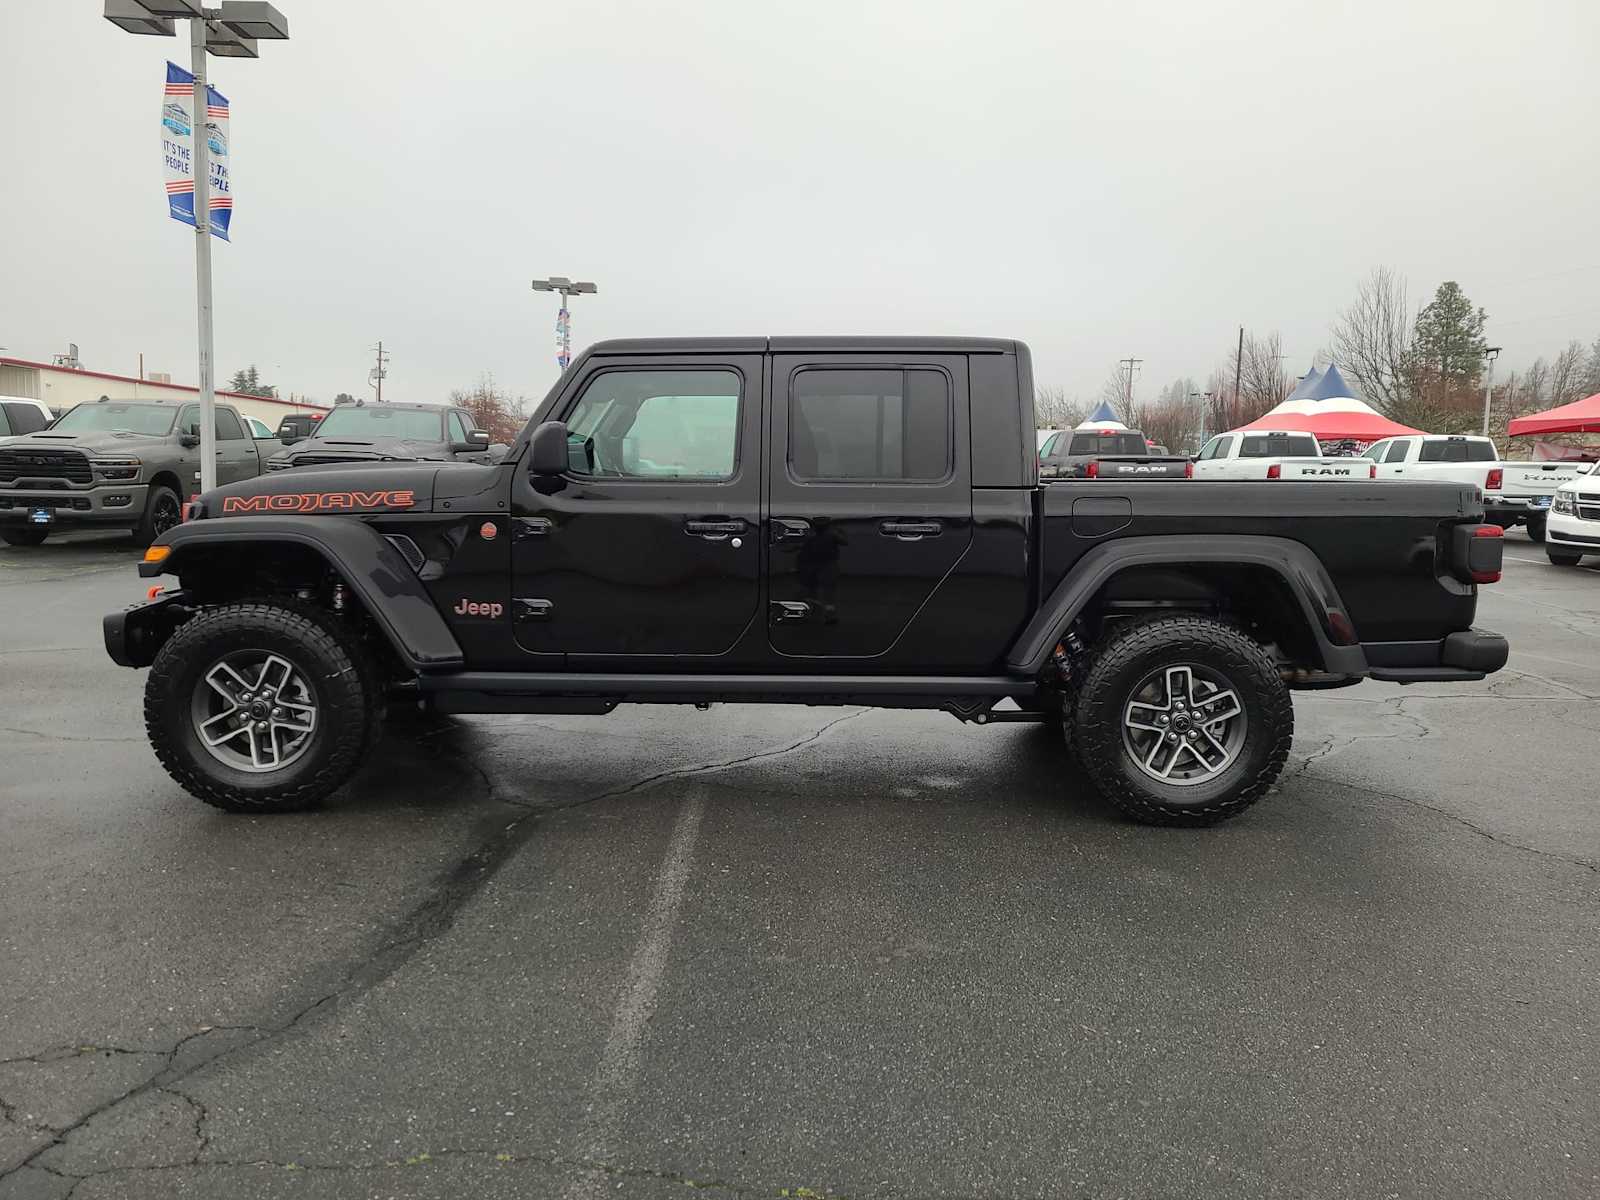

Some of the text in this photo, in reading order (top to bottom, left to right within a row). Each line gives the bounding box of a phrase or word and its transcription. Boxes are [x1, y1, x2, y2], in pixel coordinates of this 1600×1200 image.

[163, 140, 190, 161] IT'S THE
[165, 155, 189, 174] PEOPLE
[1118, 466, 1168, 474] RAM
[223, 491, 415, 512] MOJAVE
[454, 598, 503, 619] Jeep
